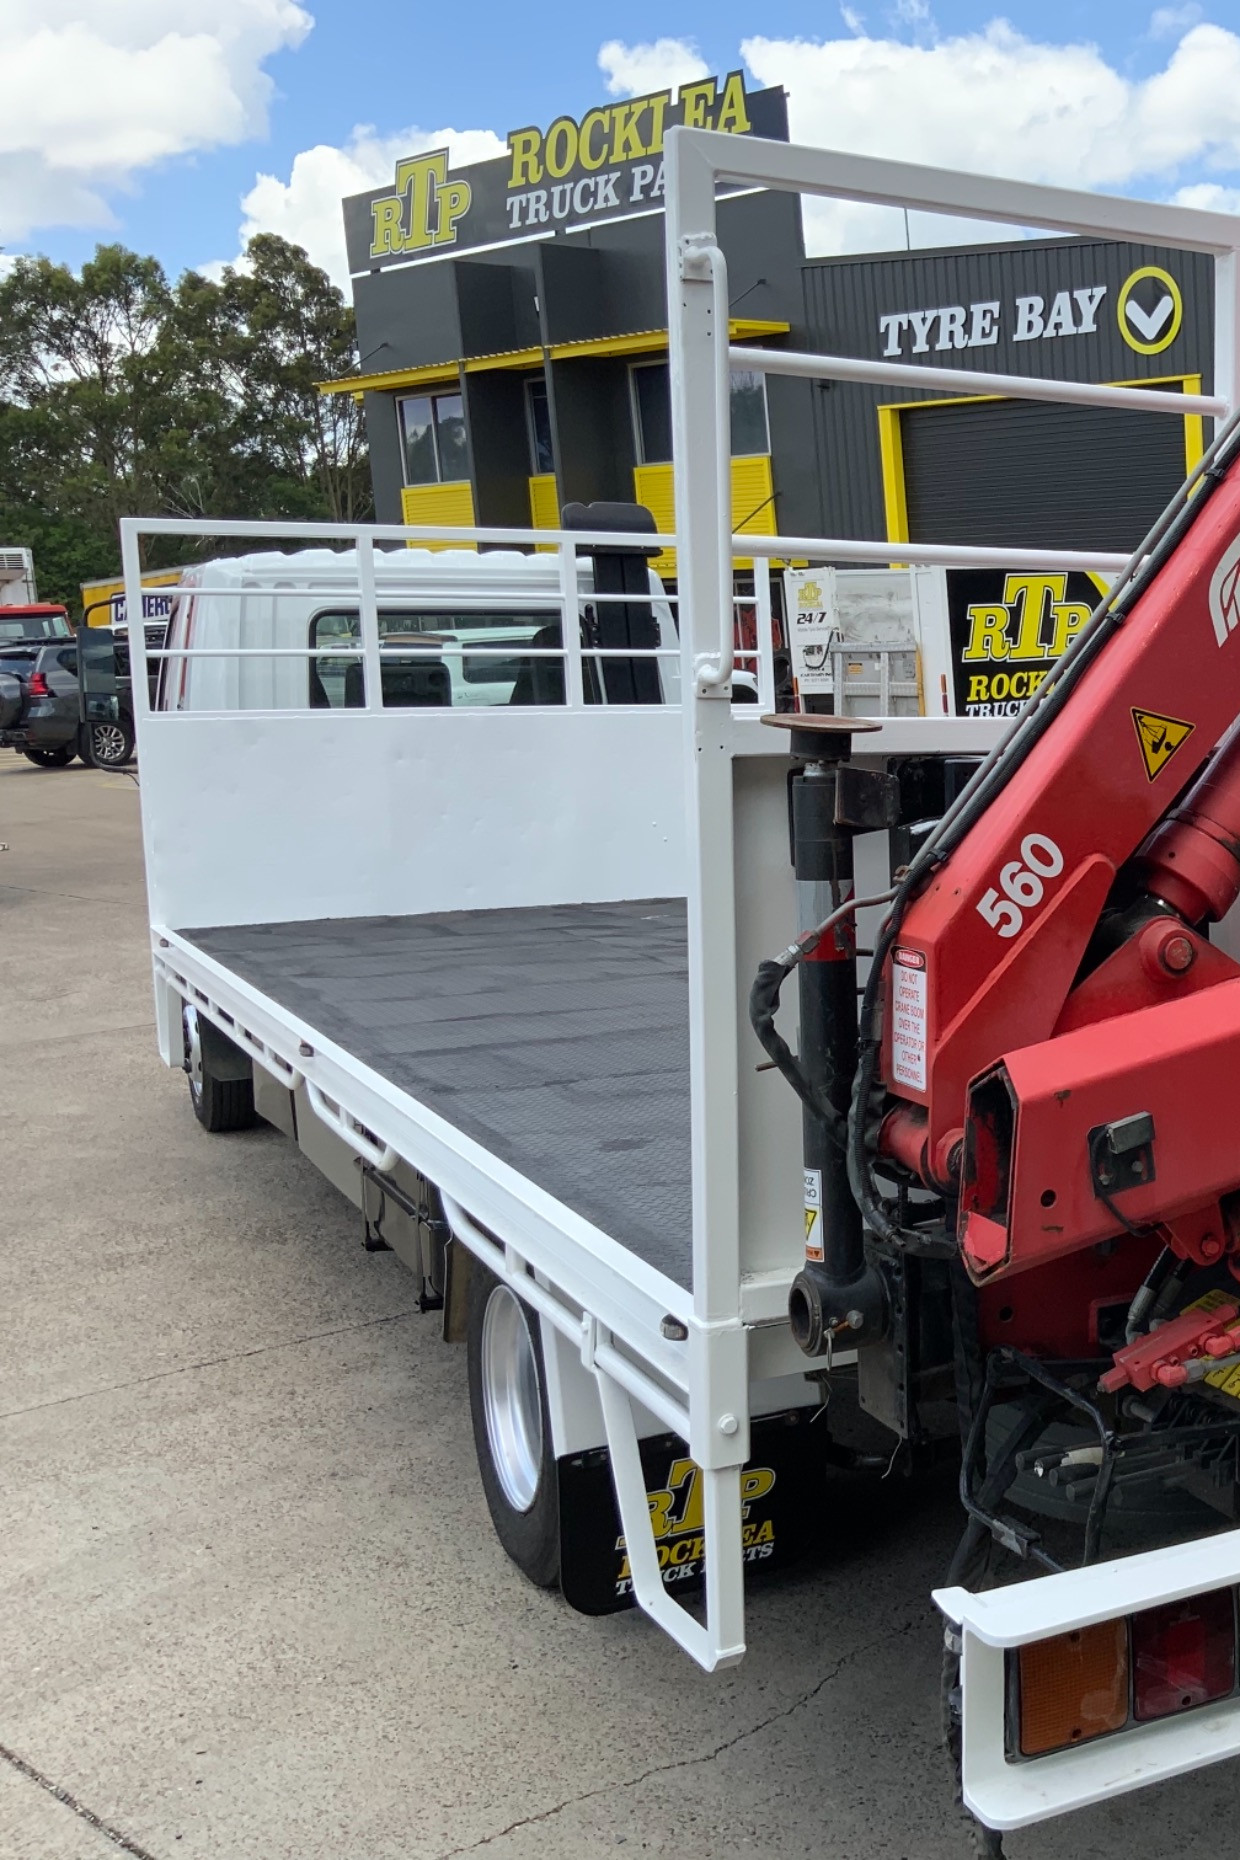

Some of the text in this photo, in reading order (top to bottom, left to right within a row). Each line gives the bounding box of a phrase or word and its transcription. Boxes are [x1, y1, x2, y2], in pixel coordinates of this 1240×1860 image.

[370, 149, 472, 259] RTP
[506, 171, 621, 229] TRUCK
[880, 286, 1107, 357] TYRE BAY
[796, 612, 827, 625] 24/7
[962, 572, 1093, 663] RTP
[976, 833, 1064, 938] 560
[895, 1000, 909, 1015] CRANE
[899, 986, 919, 1002] OPERATE
[909, 973, 918, 985] NOT
